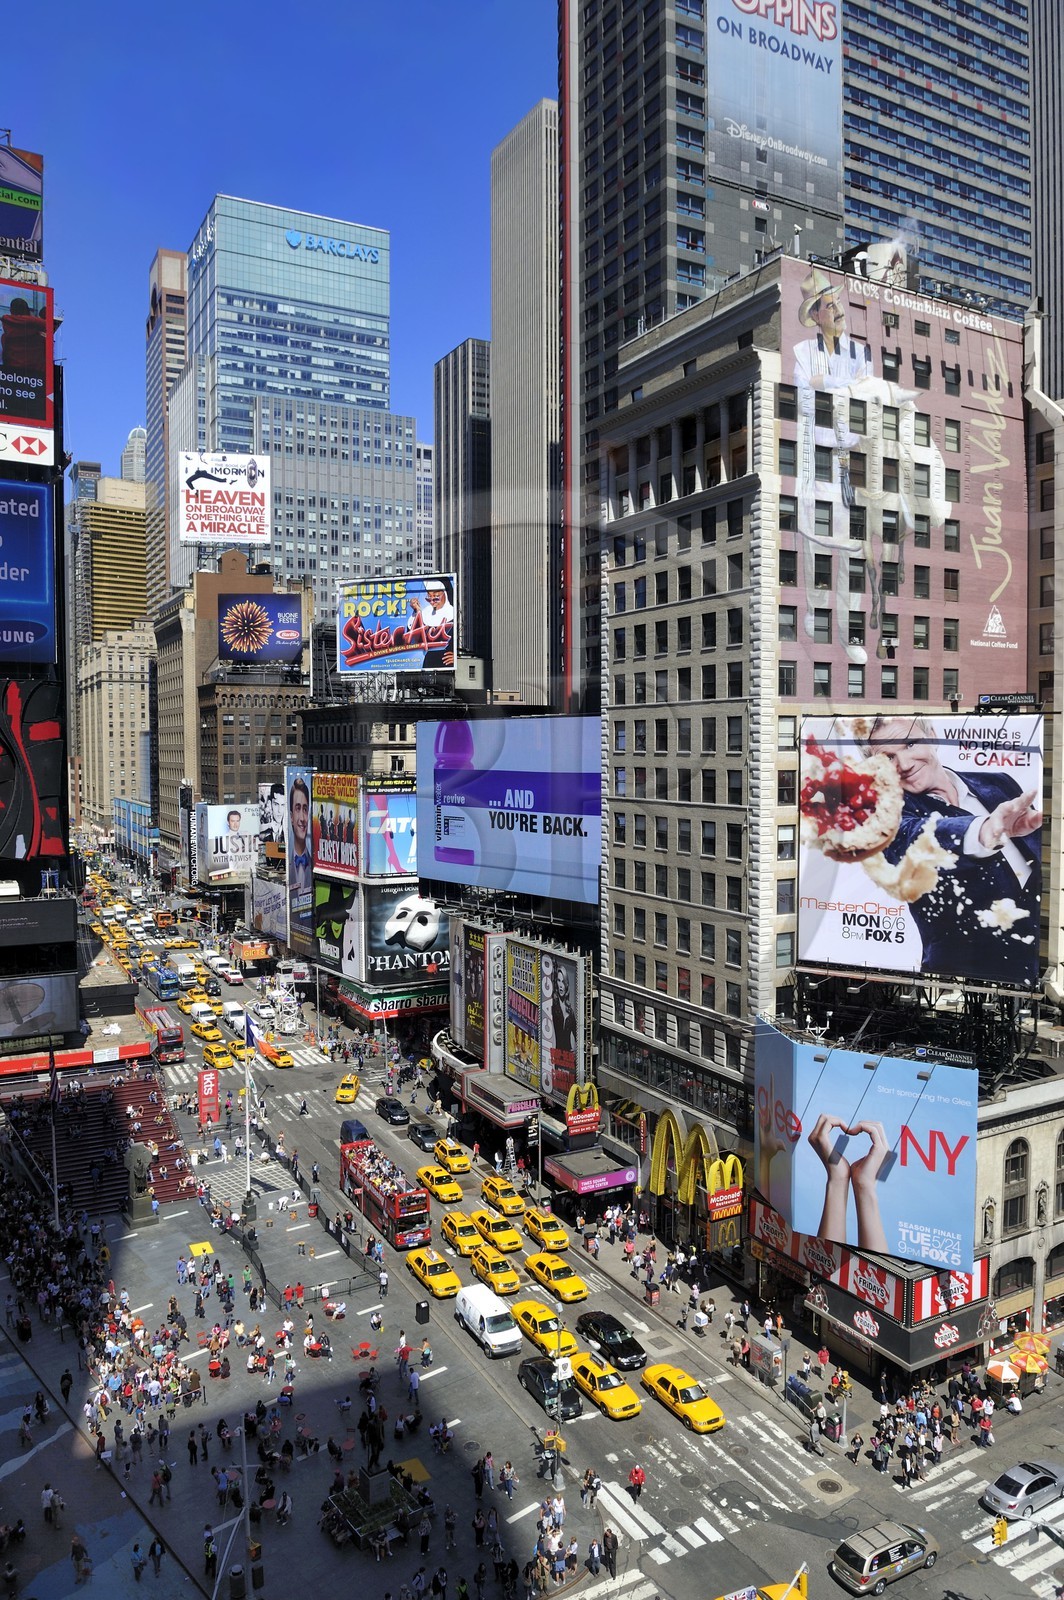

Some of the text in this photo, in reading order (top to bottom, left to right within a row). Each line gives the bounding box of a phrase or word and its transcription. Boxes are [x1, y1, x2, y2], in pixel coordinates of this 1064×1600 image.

[716, 16, 835, 74] ON BROADWAY
[305, 232, 380, 264] BARCLAYS
[849, 279, 994, 333] 100% Colombian Coffee
[15, 390, 36, 400] see
[967, 324, 1011, 475] Valdez
[186, 505, 202, 513] ON
[186, 513, 266, 523] SOMETHING LIKE
[186, 521, 198, 533] A
[969, 480, 1013, 602] Juan
[341, 611, 454, 656] Sister Act
[970, 639, 991, 648] National
[991, 641, 1006, 649] Coffee
[953, 728, 1021, 740] WINNING IS
[959, 740, 1021, 752] NO PIECE
[958, 752, 1031, 768] OF CAKE!
[316, 775, 358, 788] THE CROWD
[317, 786, 336, 797] GOES
[443, 793, 466, 804] revive
[489, 810, 538, 834] YOU'RE
[542, 815, 588, 838] BACK.
[317, 838, 340, 864] JERSEY
[799, 896, 906, 917] MasterChef
[842, 913, 906, 932] MON 6/6
[841, 926, 905, 944] 8PM FOX 5
[373, 997, 413, 1013] sbarro
[541, 953, 554, 1094] CHICAGO
[203, 1072, 216, 1096] tkts
[877, 1084, 895, 1097] Start
[896, 1087, 936, 1104] spreading
[936, 1092, 950, 1104] the
[567, 1111, 600, 1122] McDonald's
[900, 1123, 970, 1177] NY
[580, 1184, 595, 1192] VISITOR
[595, 1181, 609, 1189] CENTER
[592, 1177, 607, 1186] SQUARE
[715, 1197, 740, 1207] Restaurant
[898, 1220, 963, 1240] SEASON FINALE
[899, 1229, 961, 1254] TUE 5/24
[898, 1242, 962, 1267] 9PM FOX 5
